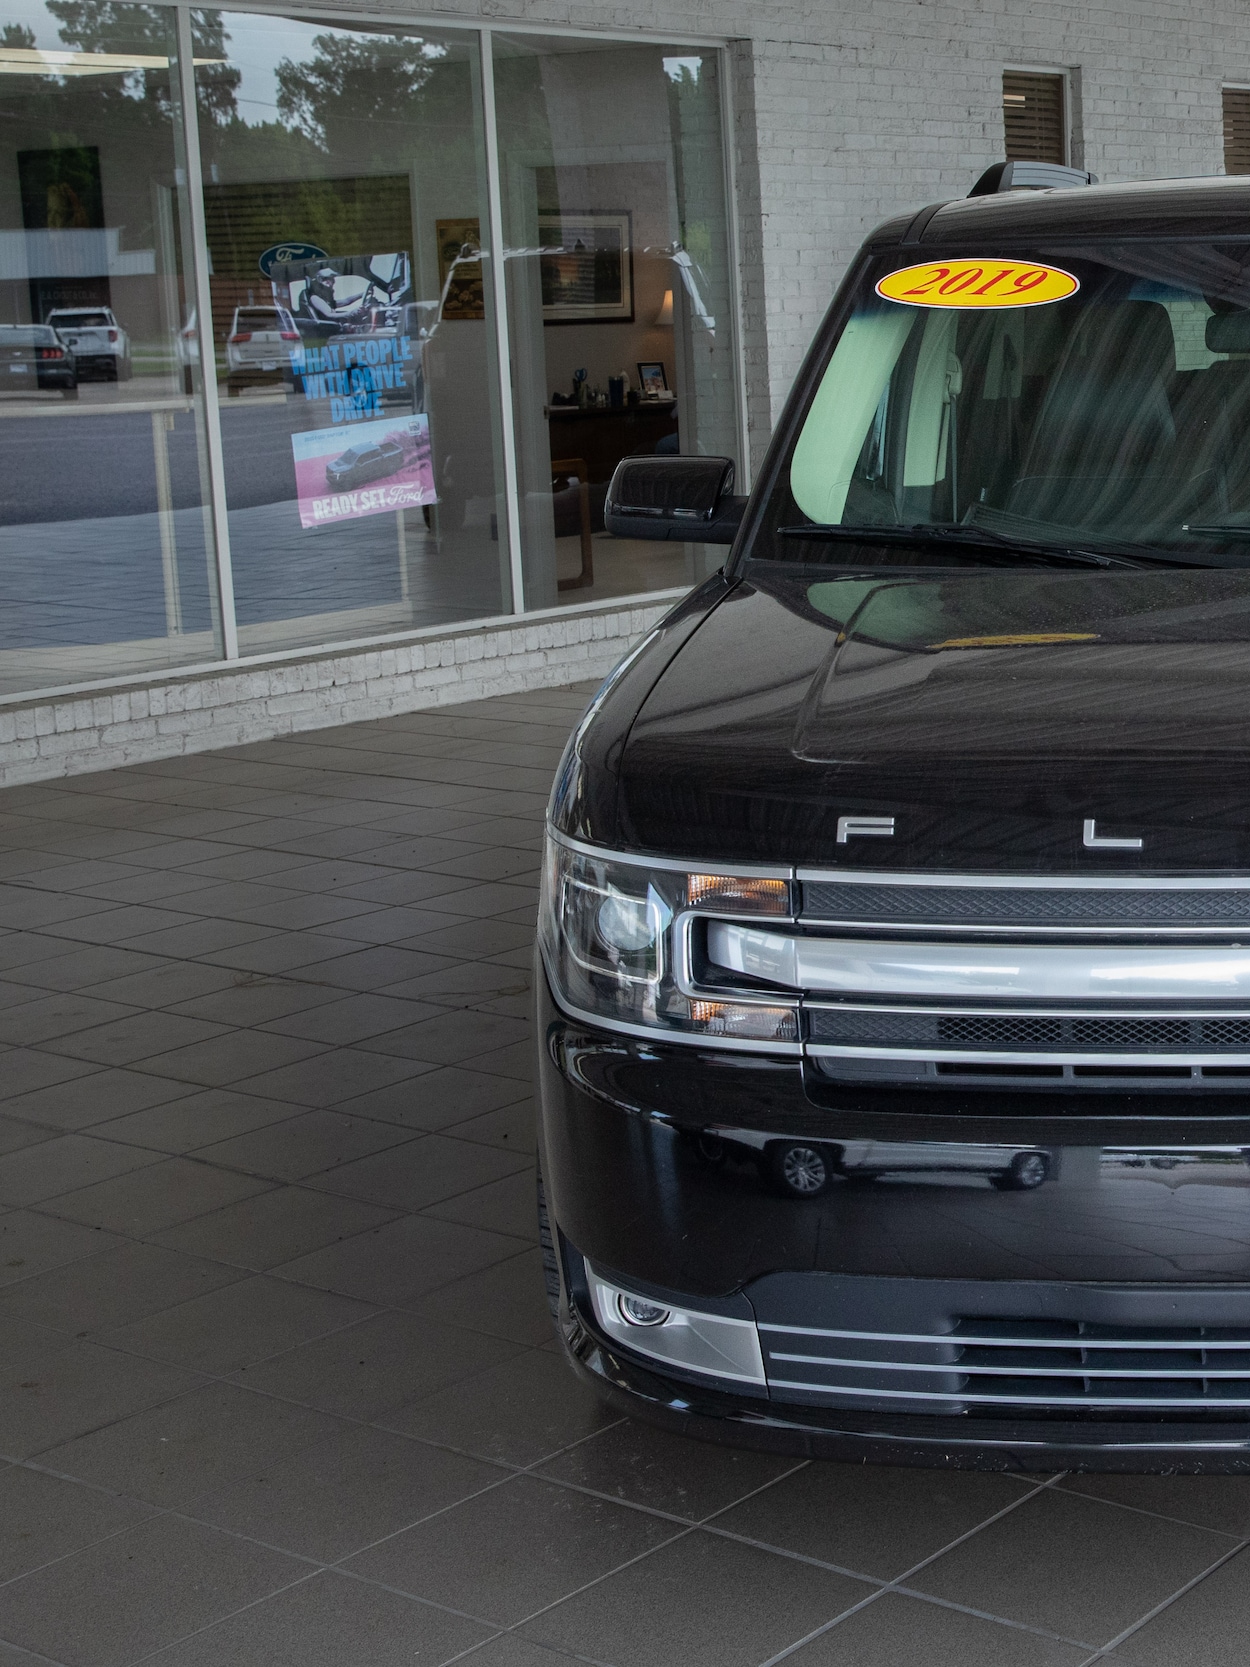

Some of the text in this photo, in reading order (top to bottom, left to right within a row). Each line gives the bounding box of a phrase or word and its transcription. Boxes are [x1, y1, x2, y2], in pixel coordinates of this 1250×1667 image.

[901, 267, 1049, 297] 2019
[290, 336, 413, 376] WHAT PEOPLE
[302, 363, 407, 400] WITH DRIVE
[330, 391, 385, 423] DRIVE
[312, 484, 424, 520] READY SET Ford
